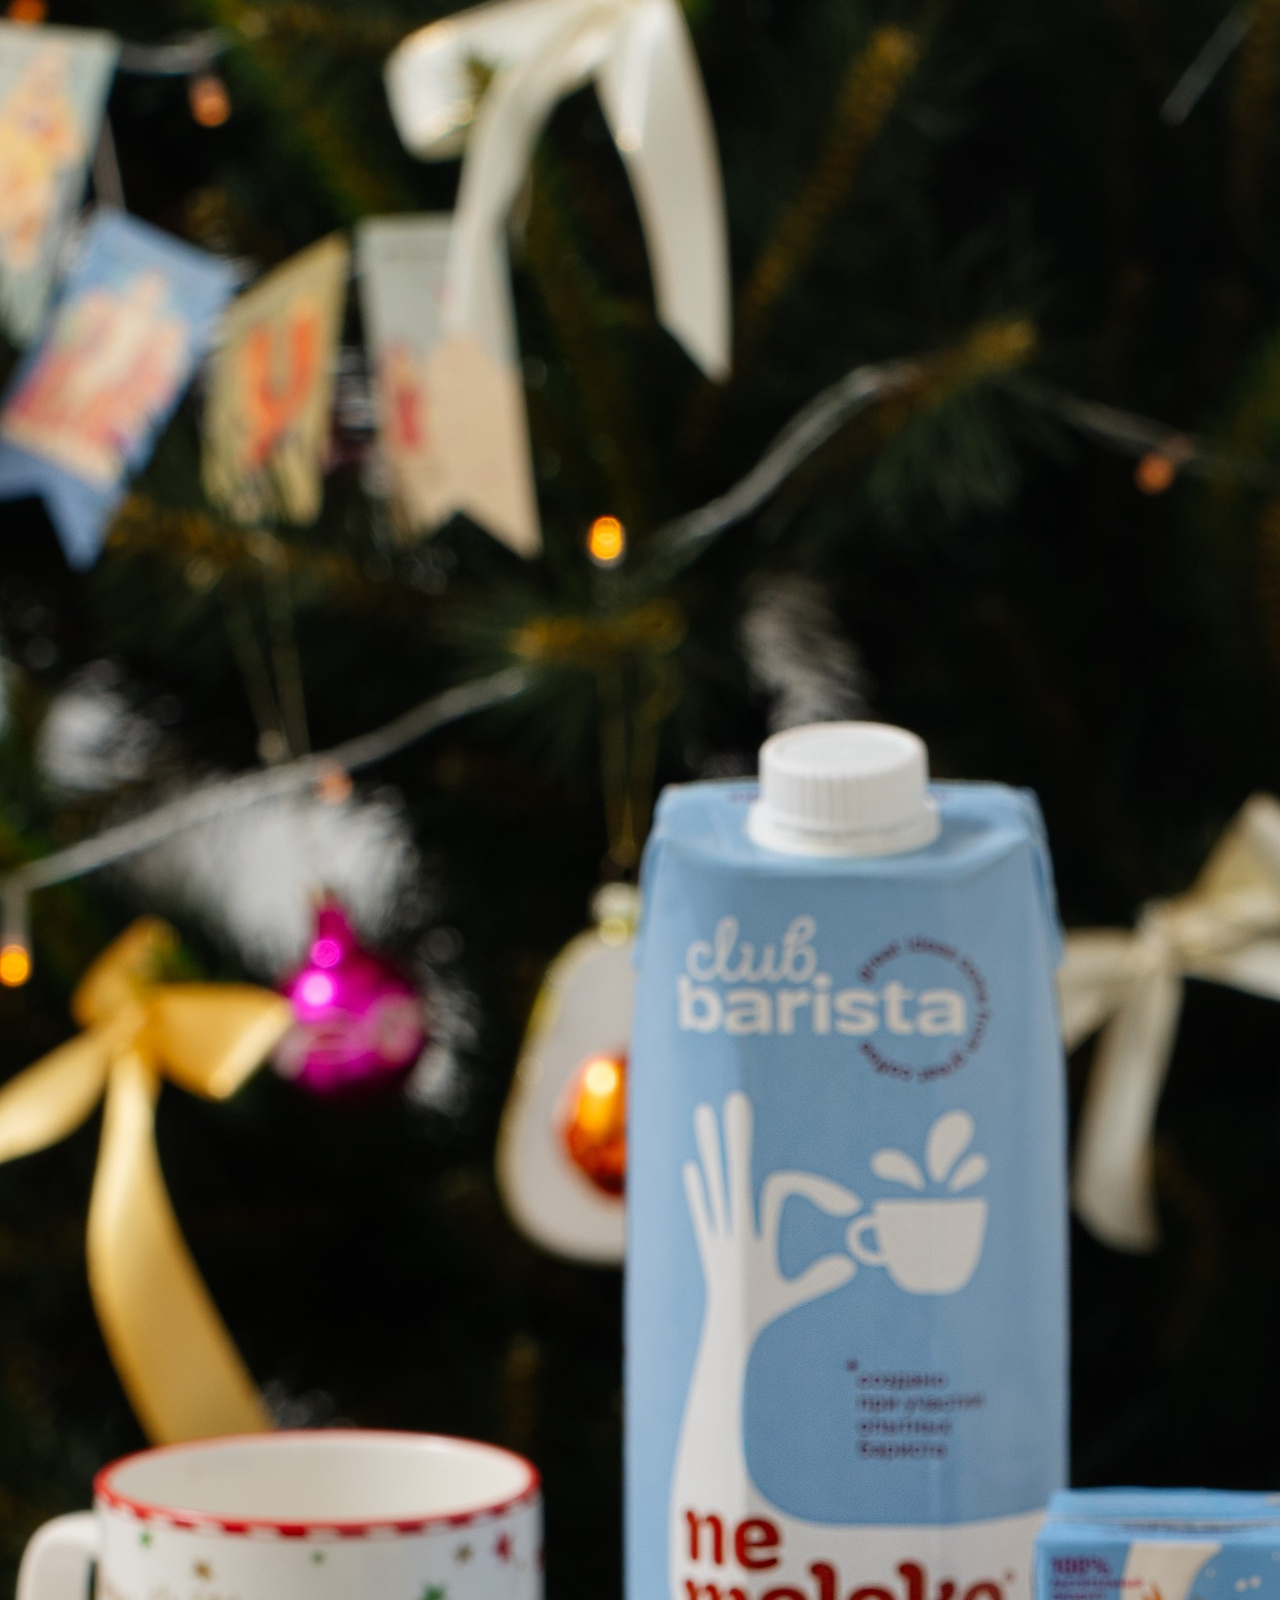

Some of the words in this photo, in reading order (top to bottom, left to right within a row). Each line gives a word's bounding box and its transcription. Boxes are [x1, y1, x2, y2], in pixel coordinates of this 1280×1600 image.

[686, 915, 817, 984] club
[677, 973, 966, 1036] barista
[684, 1510, 780, 1569] ne
